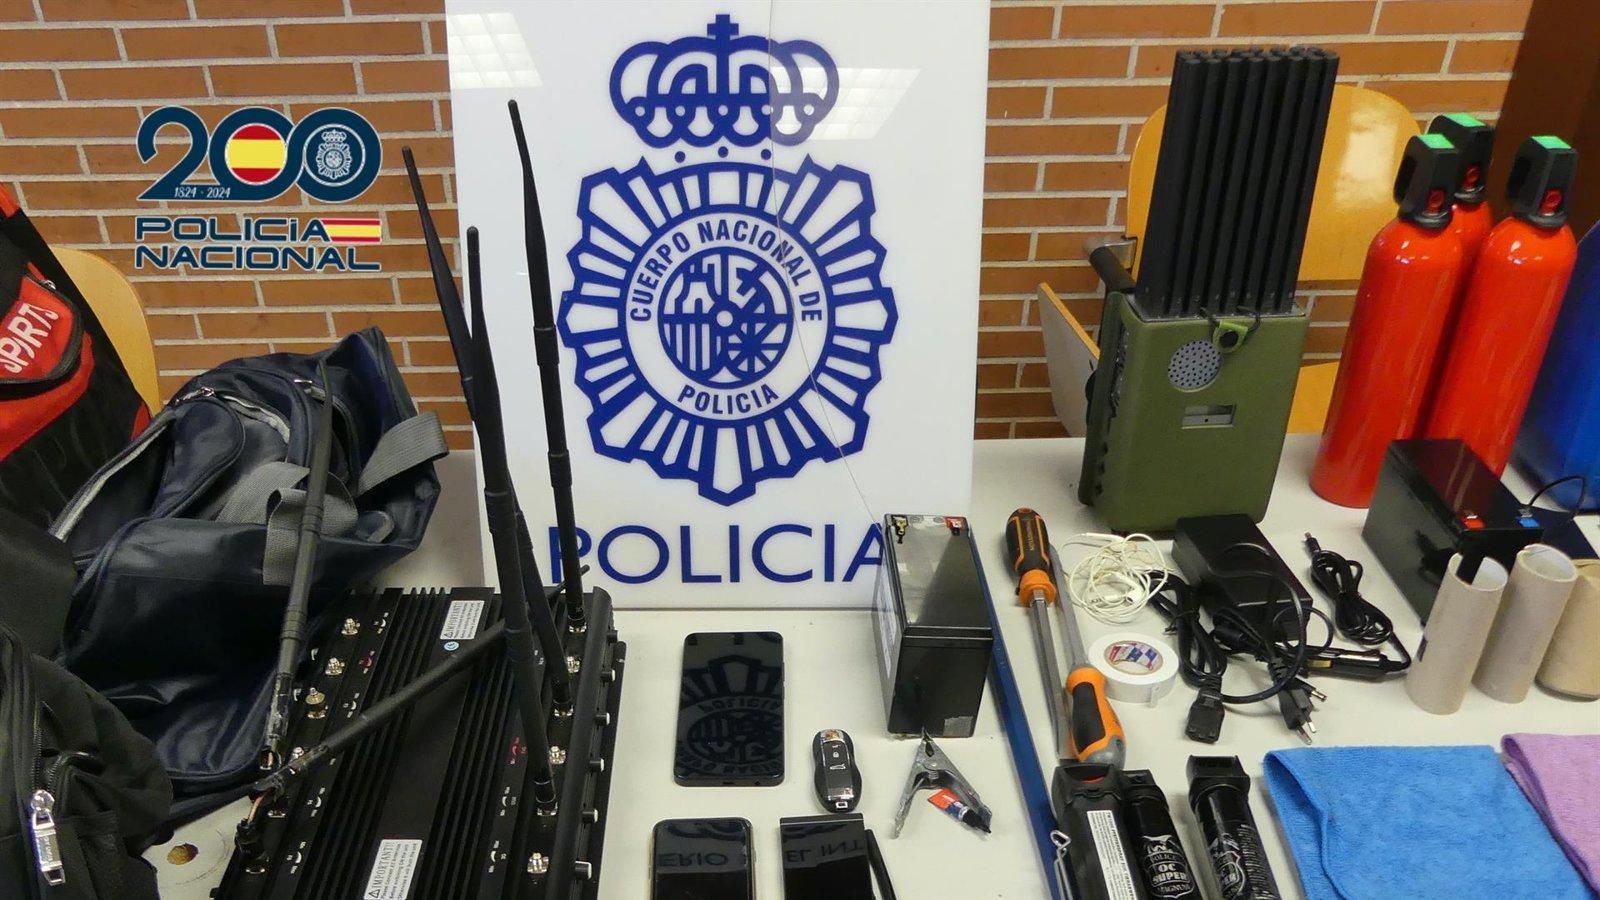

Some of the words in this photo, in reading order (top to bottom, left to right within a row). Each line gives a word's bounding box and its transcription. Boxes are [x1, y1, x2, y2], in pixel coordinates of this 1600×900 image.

[630, 231, 692, 322] CUERPO
[697, 219, 812, 287] NACIONAL
[799, 291, 822, 322] DE
[677, 384, 779, 415] POLICIA
[548, 523, 885, 584] POLICIA
[1158, 863, 1176, 872] OC
